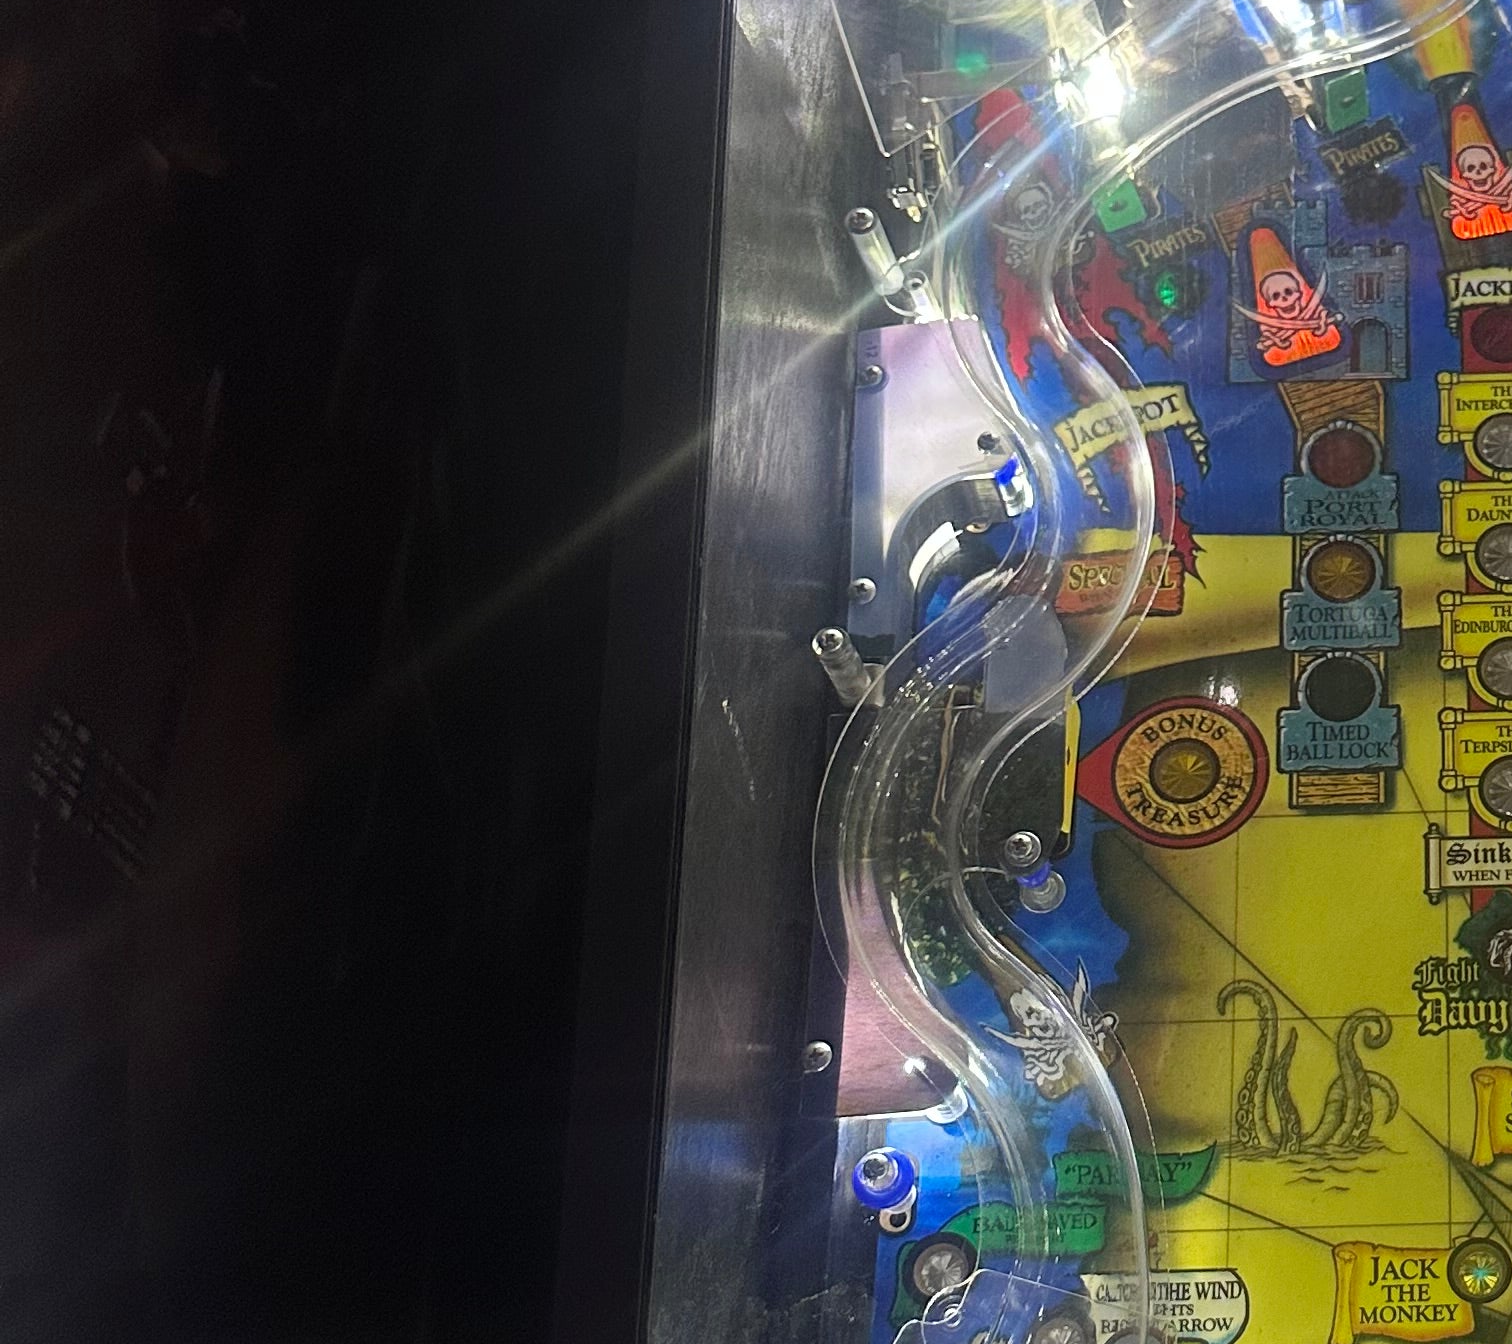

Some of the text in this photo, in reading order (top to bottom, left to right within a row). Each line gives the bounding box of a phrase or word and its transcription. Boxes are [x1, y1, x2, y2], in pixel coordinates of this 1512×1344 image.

[1328, 129, 1399, 174] PIRATES
[1133, 226, 1207, 266] PIRATES
[1305, 500, 1382, 514] PORT
[1301, 514, 1385, 526] ROYAL
[1293, 604, 1388, 623] TORTUGA
[1292, 623, 1392, 640] MULTIBALL
[1140, 714, 1227, 743] BONUS
[1306, 722, 1370, 742] TIMED
[1286, 741, 1389, 761] BALL LOCK
[1127, 774, 1243, 827] TREASURE
[1446, 842, 1512, 866] Sink
[1452, 869, 1501, 881] WHEN
[1412, 957, 1480, 991] Fight
[1419, 989, 1512, 1036] Davy
[1369, 1256, 1440, 1286] JACK
[1196, 1281, 1243, 1301] WIND
[1381, 1284, 1431, 1303] THE
[1359, 1303, 1460, 1324] MONKEY
